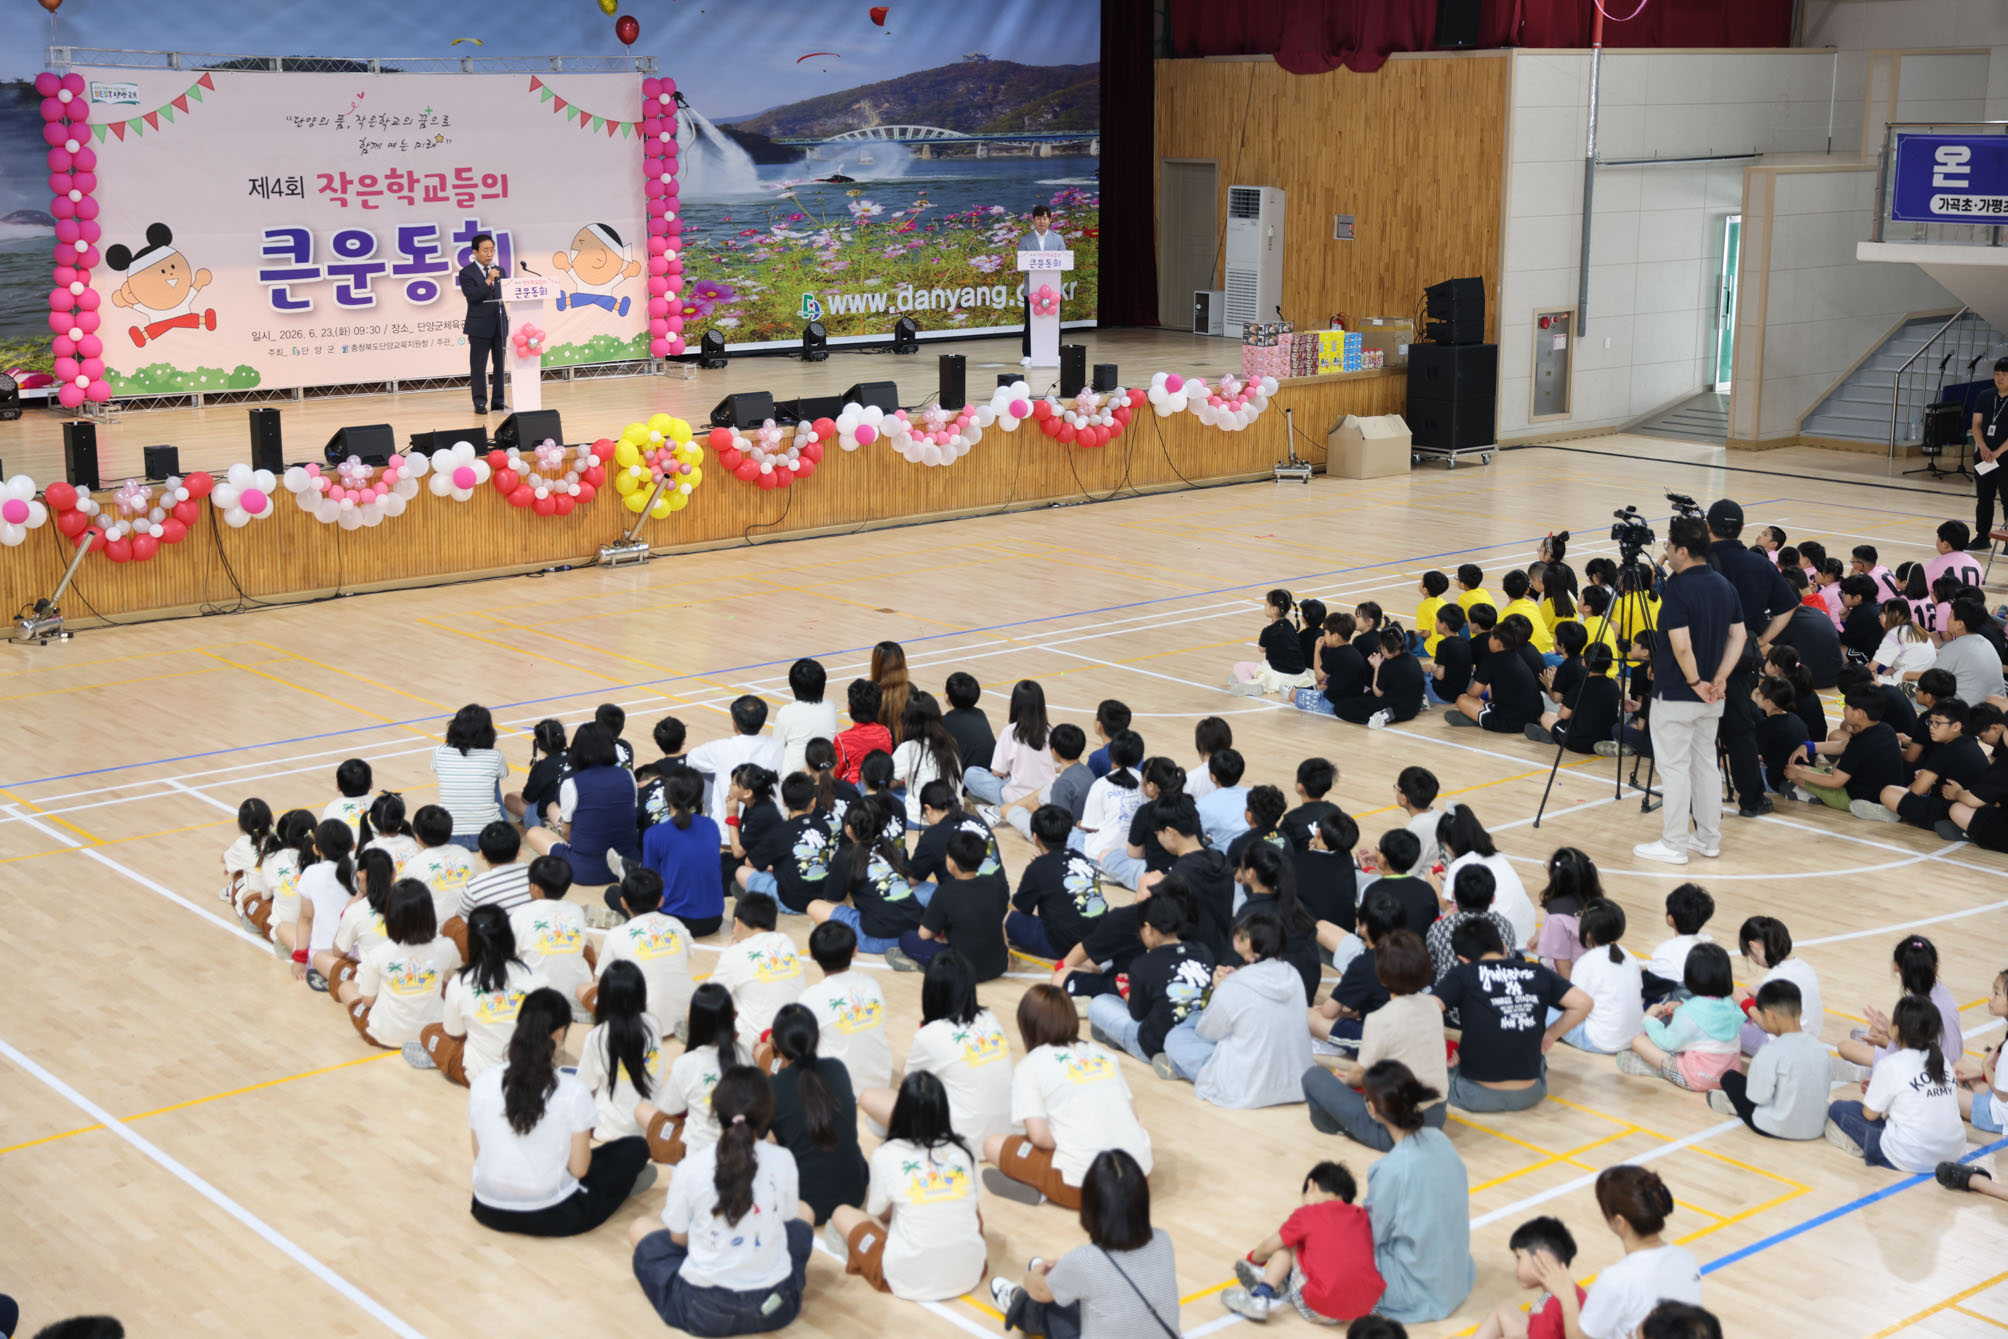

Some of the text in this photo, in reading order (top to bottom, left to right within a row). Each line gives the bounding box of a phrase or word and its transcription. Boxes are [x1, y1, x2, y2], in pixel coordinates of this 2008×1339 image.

[355, 113, 413, 132] 작은학교의
[418, 114, 451, 129] 꿈으로
[1932, 145, 1972, 188] 온
[249, 166, 509, 210] 제4회 작은학교들의
[353, 325, 381, 336] 09:30
[1926, 1087, 1953, 1098] ARMY
